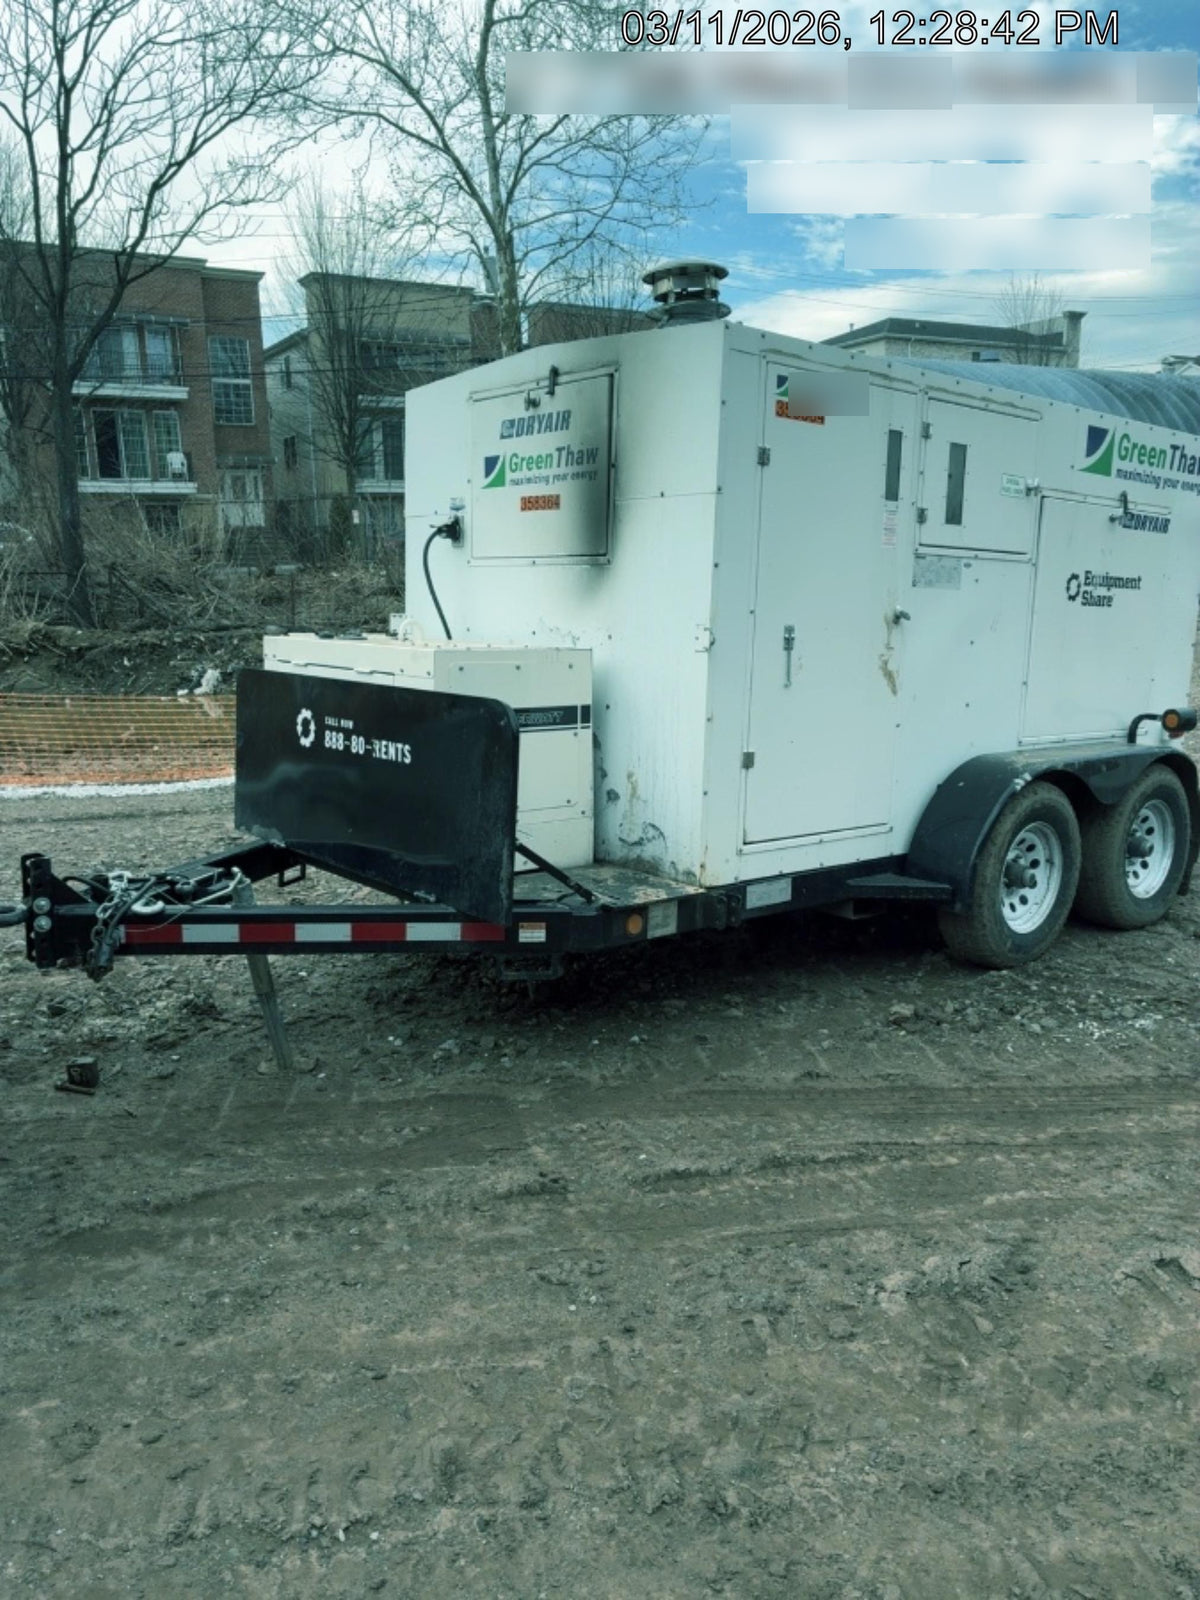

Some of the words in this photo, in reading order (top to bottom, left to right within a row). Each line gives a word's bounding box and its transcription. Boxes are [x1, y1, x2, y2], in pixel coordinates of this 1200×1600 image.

[509, 474, 550, 486] maximizing
[552, 472, 568, 485] your
[571, 469, 599, 482] energy
[1115, 468, 1162, 490] maximizing
[1162, 477, 1180, 490] your
[1083, 570, 1142, 592] Equipment
[1081, 589, 1114, 608] Share
[324, 716, 339, 727] CALL
[340, 718, 354, 730] NOW
